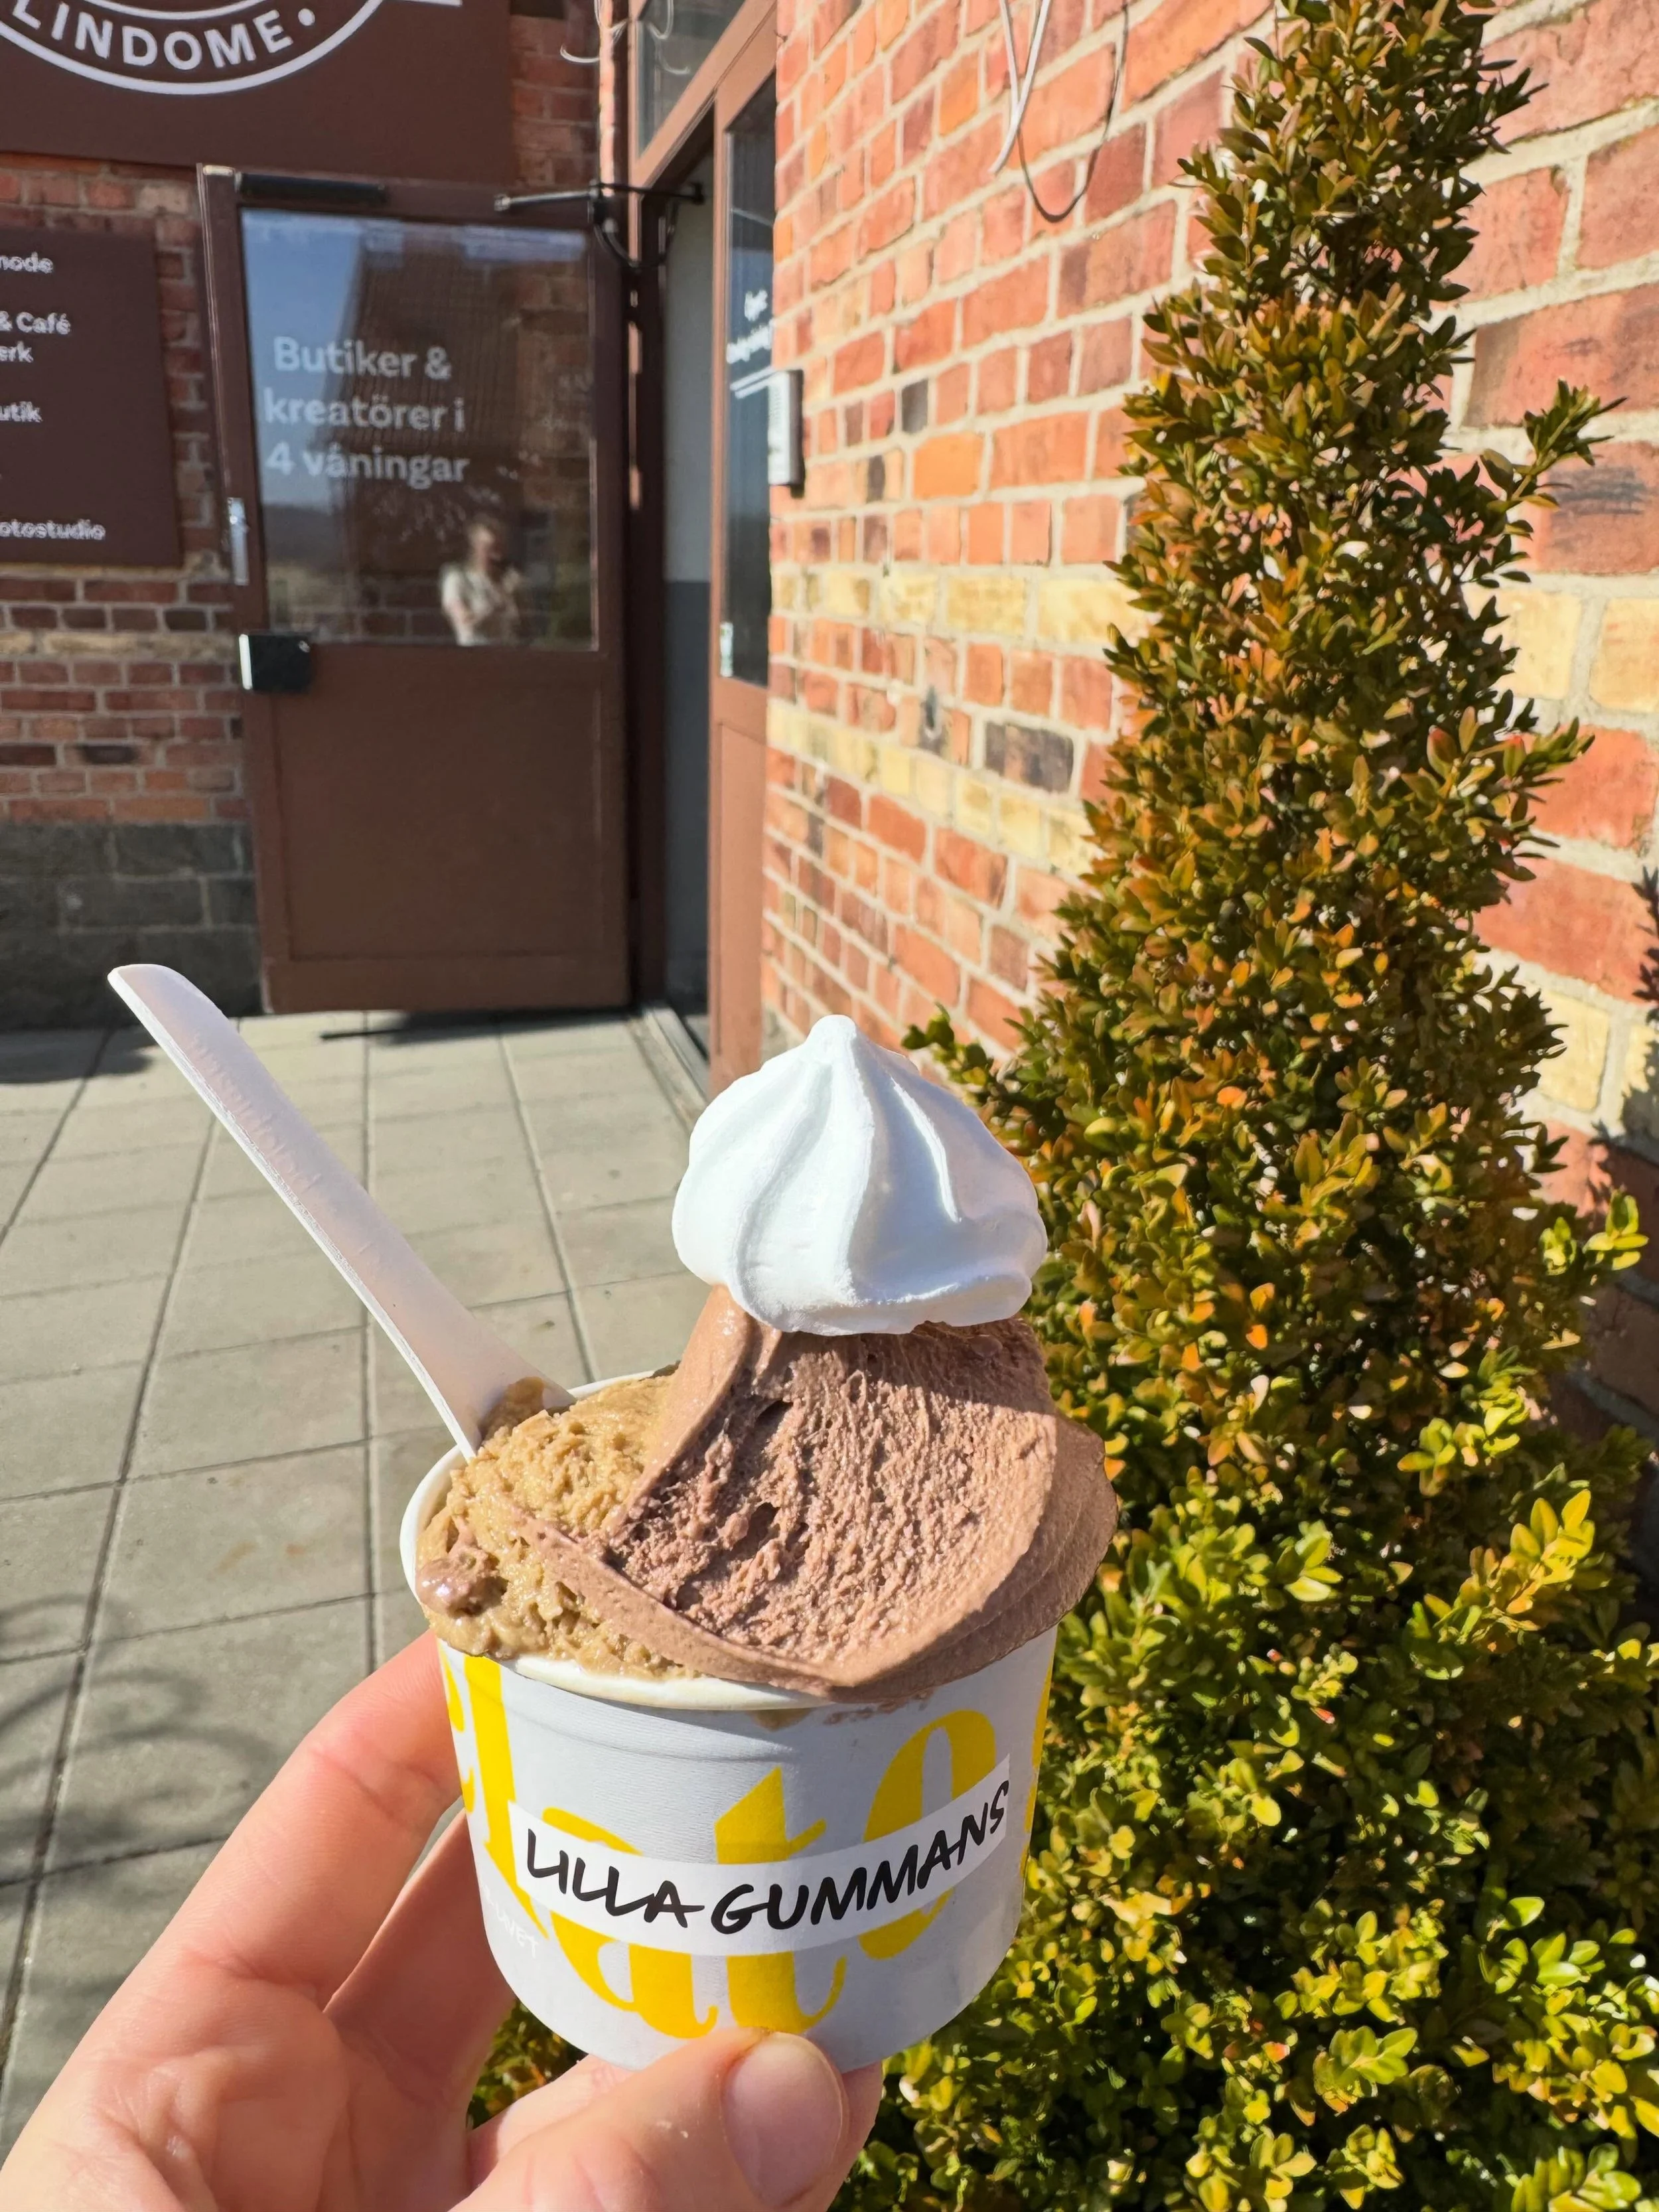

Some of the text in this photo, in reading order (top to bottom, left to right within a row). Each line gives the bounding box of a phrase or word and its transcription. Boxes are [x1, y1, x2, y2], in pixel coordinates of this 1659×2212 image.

[12, 0, 293, 70] LINDOME
[16, 311, 71, 334] Café
[273, 336, 452, 380] Butiker &
[264, 386, 465, 433] kreatörer i
[267, 441, 470, 490] 4 våningar
[527, 1780, 1009, 1935] LILLA GUMMANS
